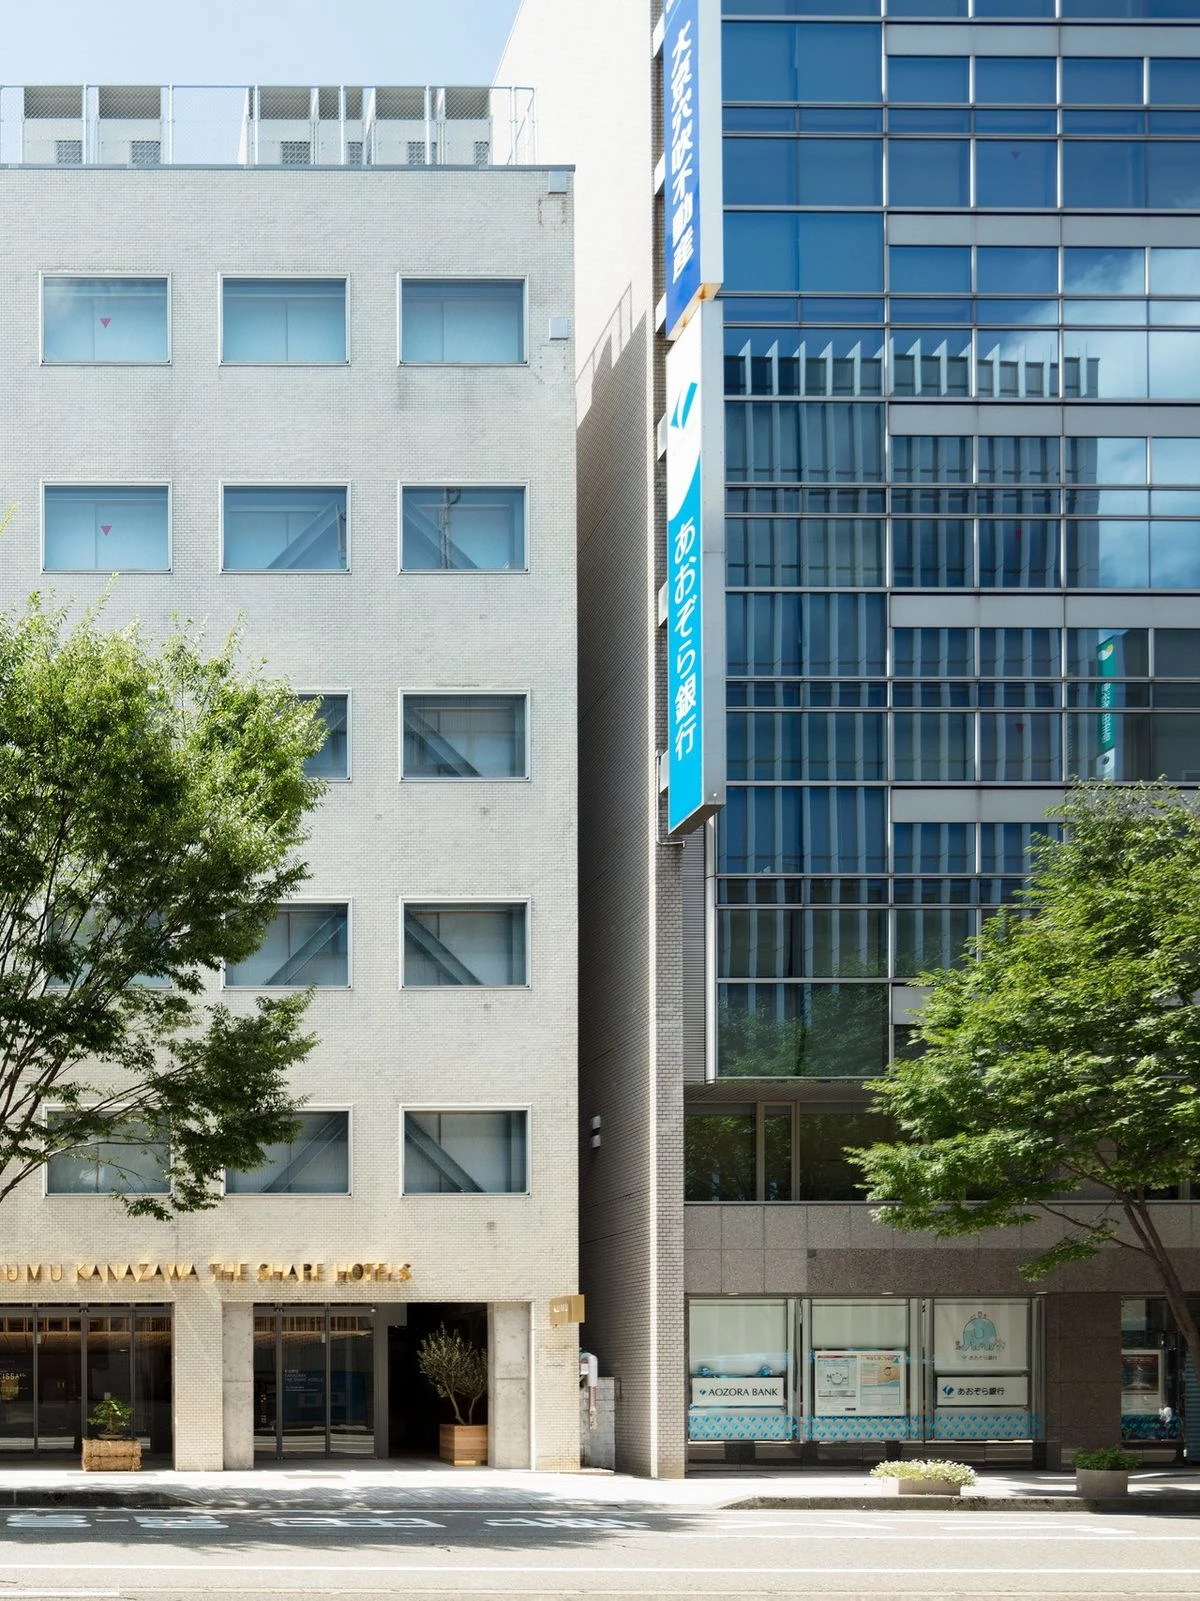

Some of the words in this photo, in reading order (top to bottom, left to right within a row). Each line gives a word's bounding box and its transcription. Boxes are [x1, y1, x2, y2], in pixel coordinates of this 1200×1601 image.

[671, 19, 693, 284] 大京穴吹不動産
[674, 516, 697, 761] あおぞら銀行
[77, 1263, 200, 1282] KANAZAWA
[209, 1263, 249, 1282] THE
[257, 1263, 325, 1282] SHARE
[334, 1263, 412, 1282] HOTELS
[708, 1388, 750, 1396] AOZORA
[752, 1388, 778, 1396] BANK
[957, 1387, 1005, 1396] あおぞら銀行
